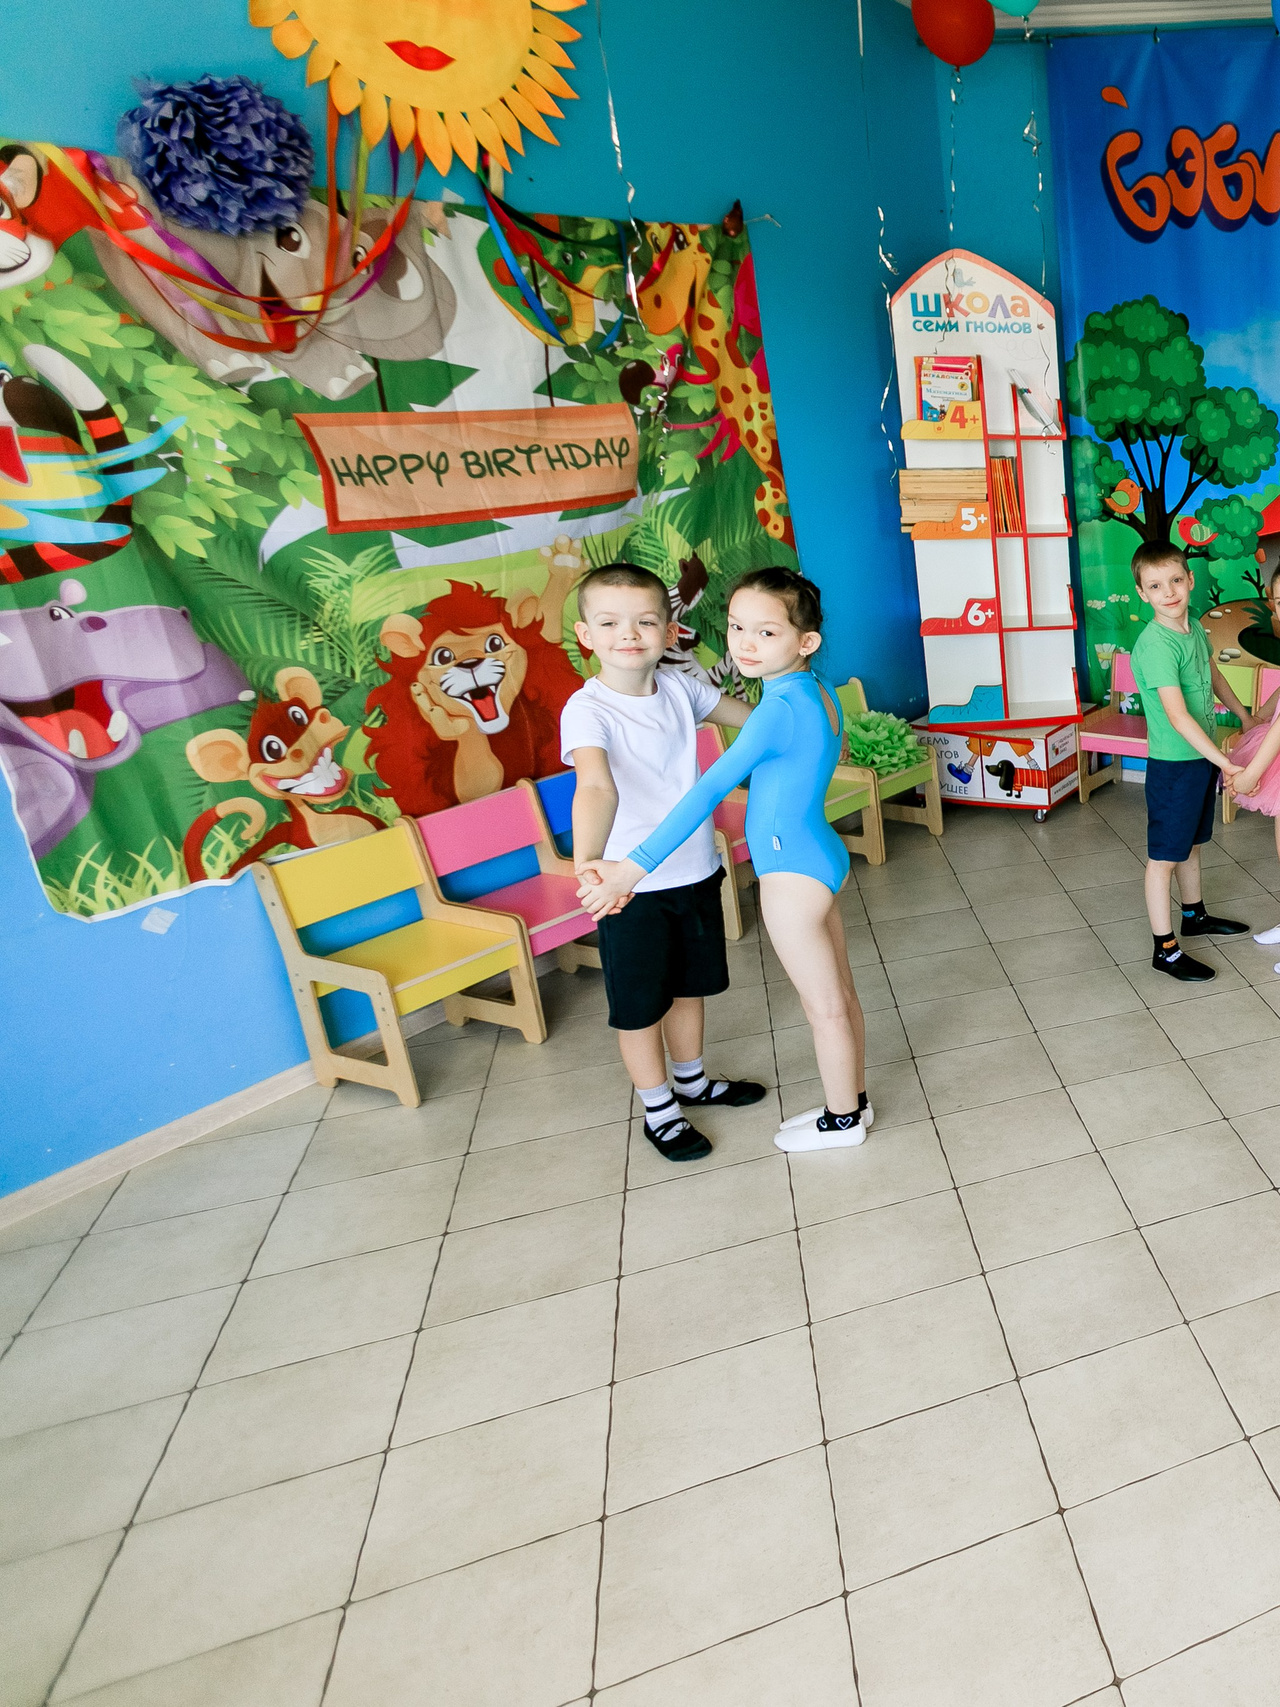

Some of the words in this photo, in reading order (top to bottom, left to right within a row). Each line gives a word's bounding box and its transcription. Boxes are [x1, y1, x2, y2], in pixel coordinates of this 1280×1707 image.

[950, 405, 979, 429] 4+
[330, 450, 449, 487] HAPPY
[460, 437, 630, 479] BIRTHDAY
[960, 507, 988, 531] 5+
[967, 602, 995, 627] 6+
[919, 736, 950, 745] СЕМЬ
